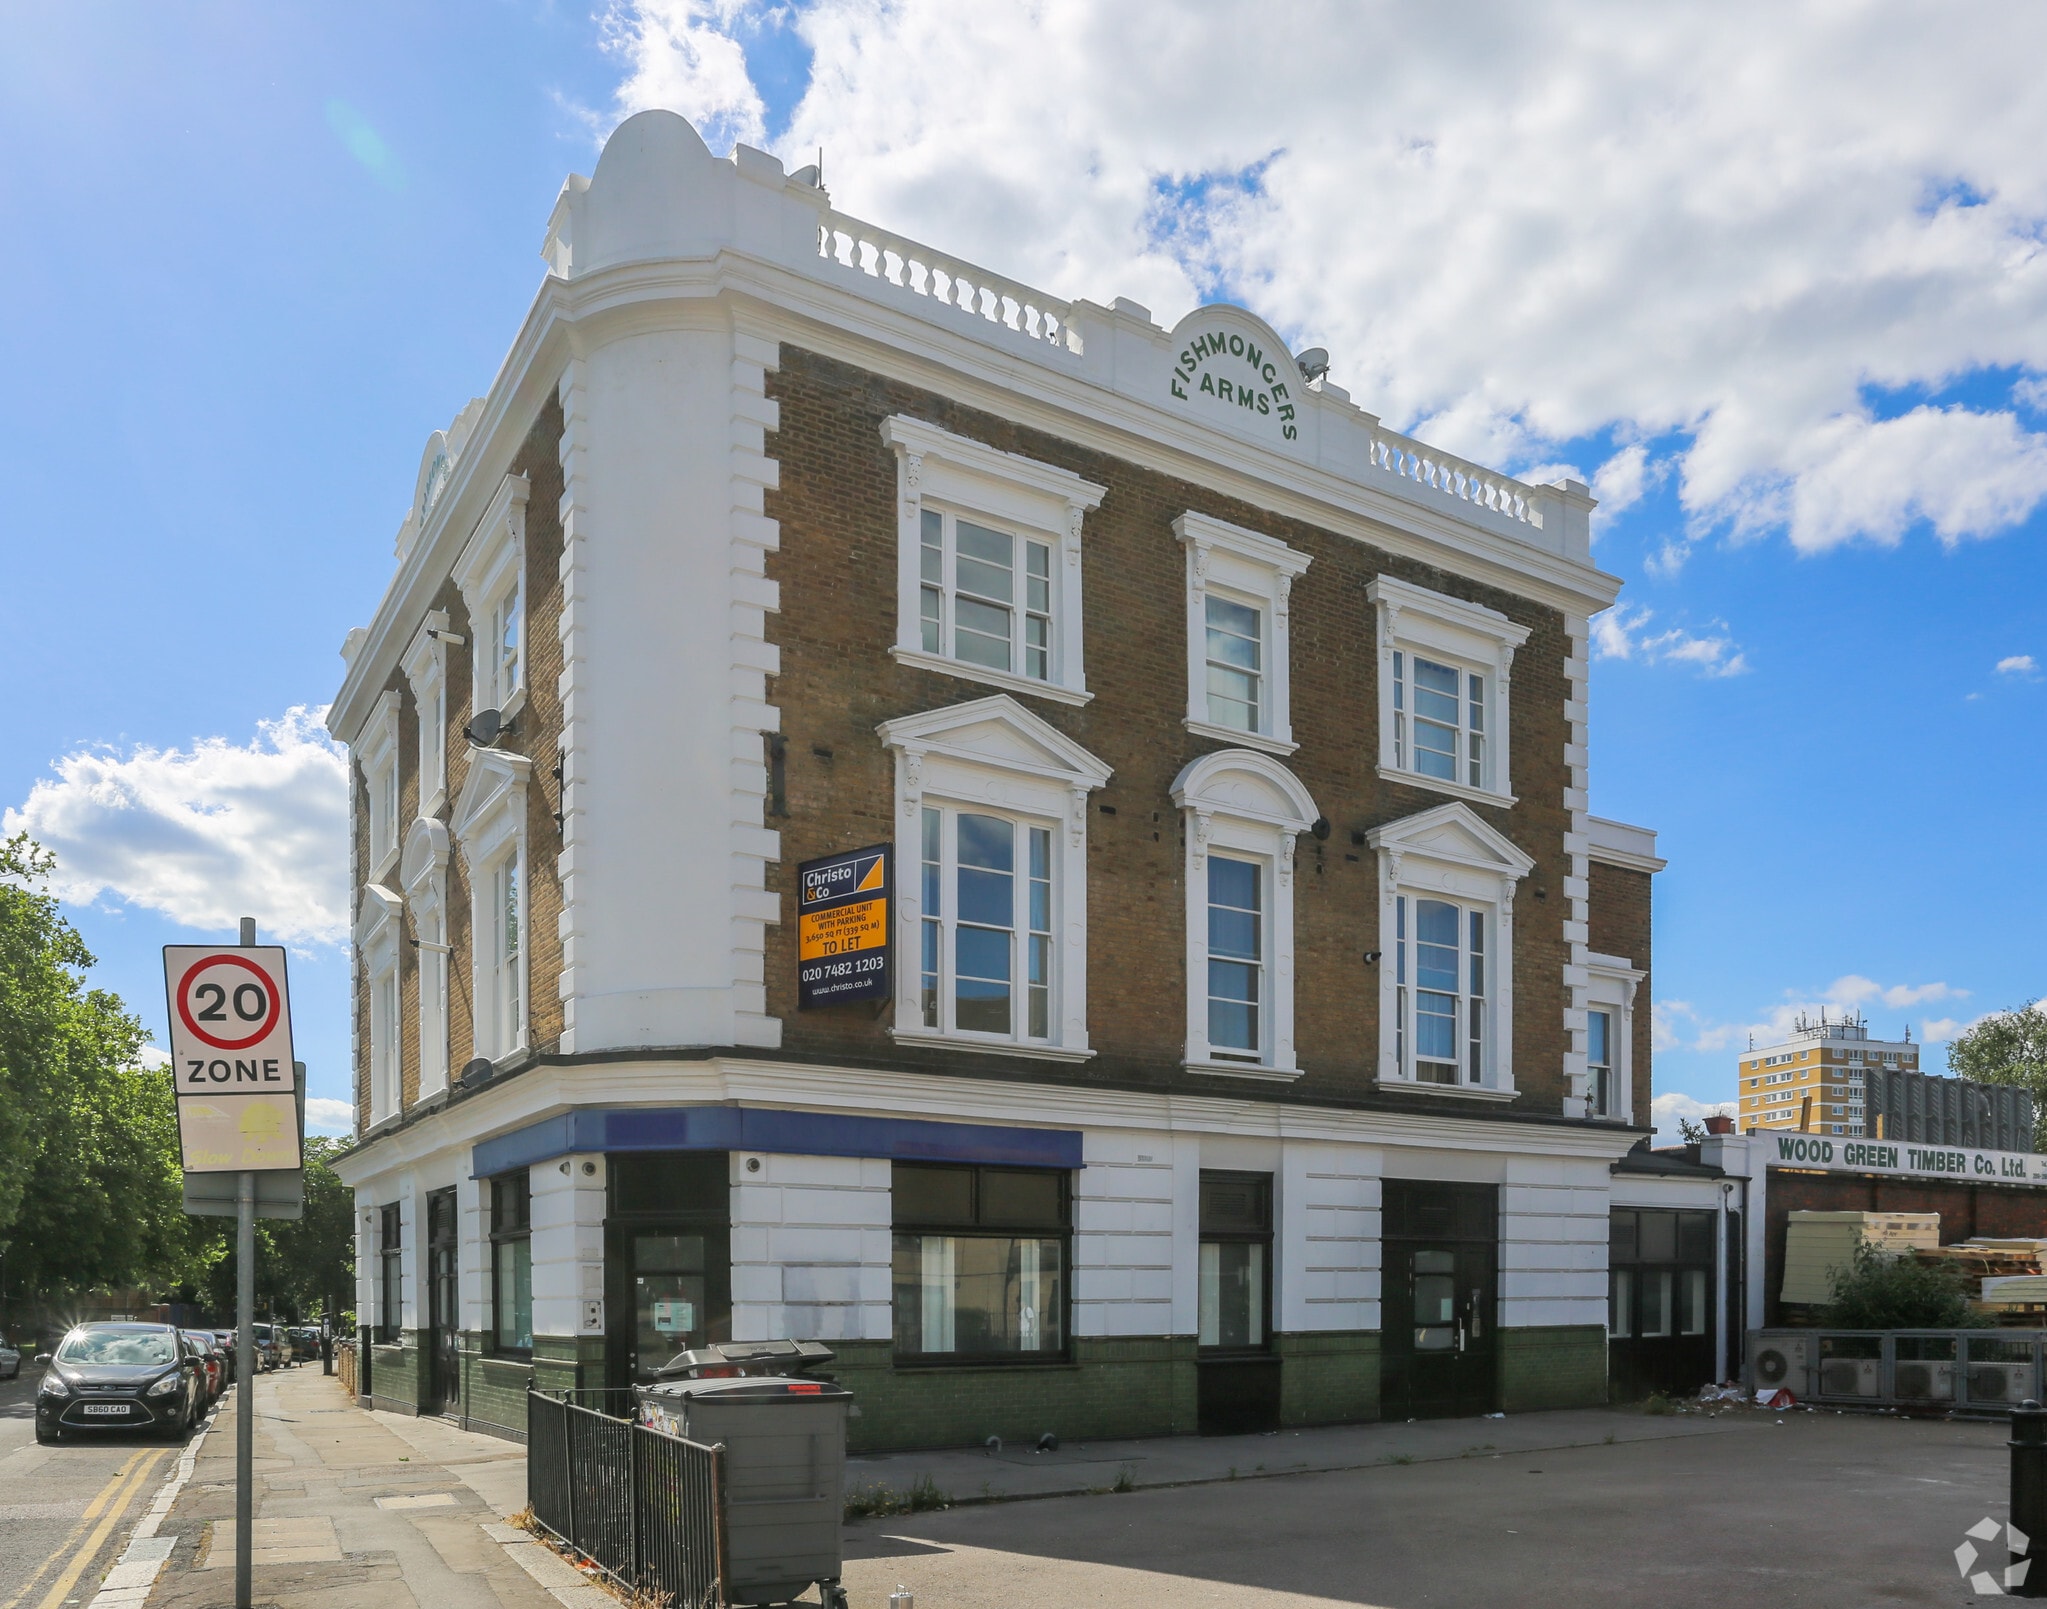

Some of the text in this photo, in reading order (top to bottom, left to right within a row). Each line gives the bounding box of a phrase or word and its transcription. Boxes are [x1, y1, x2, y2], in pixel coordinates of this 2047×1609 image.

[1200, 372, 1270, 415] ARMS
[806, 867, 852, 887] Christo
[806, 887, 830, 900] &Co
[811, 902, 873, 922] COMMERCIAL UNIT
[818, 913, 866, 930] WITH PARKING
[825, 930, 834, 938] SQ
[844, 926, 858, 936] (339
[860, 923, 869, 931] SQ
[871, 920, 880, 930] M)
[822, 935, 861, 955] TO LET
[802, 956, 884, 982] 020 7482 1203
[812, 978, 873, 996] www.christo.co.uk
[195, 983, 267, 1022] 20
[187, 1059, 281, 1083] ZONE
[1778, 1137, 2026, 1178] WOOD GREEN TIMBER Co. Ltd.
[87, 1405, 109, 1413] SB60
